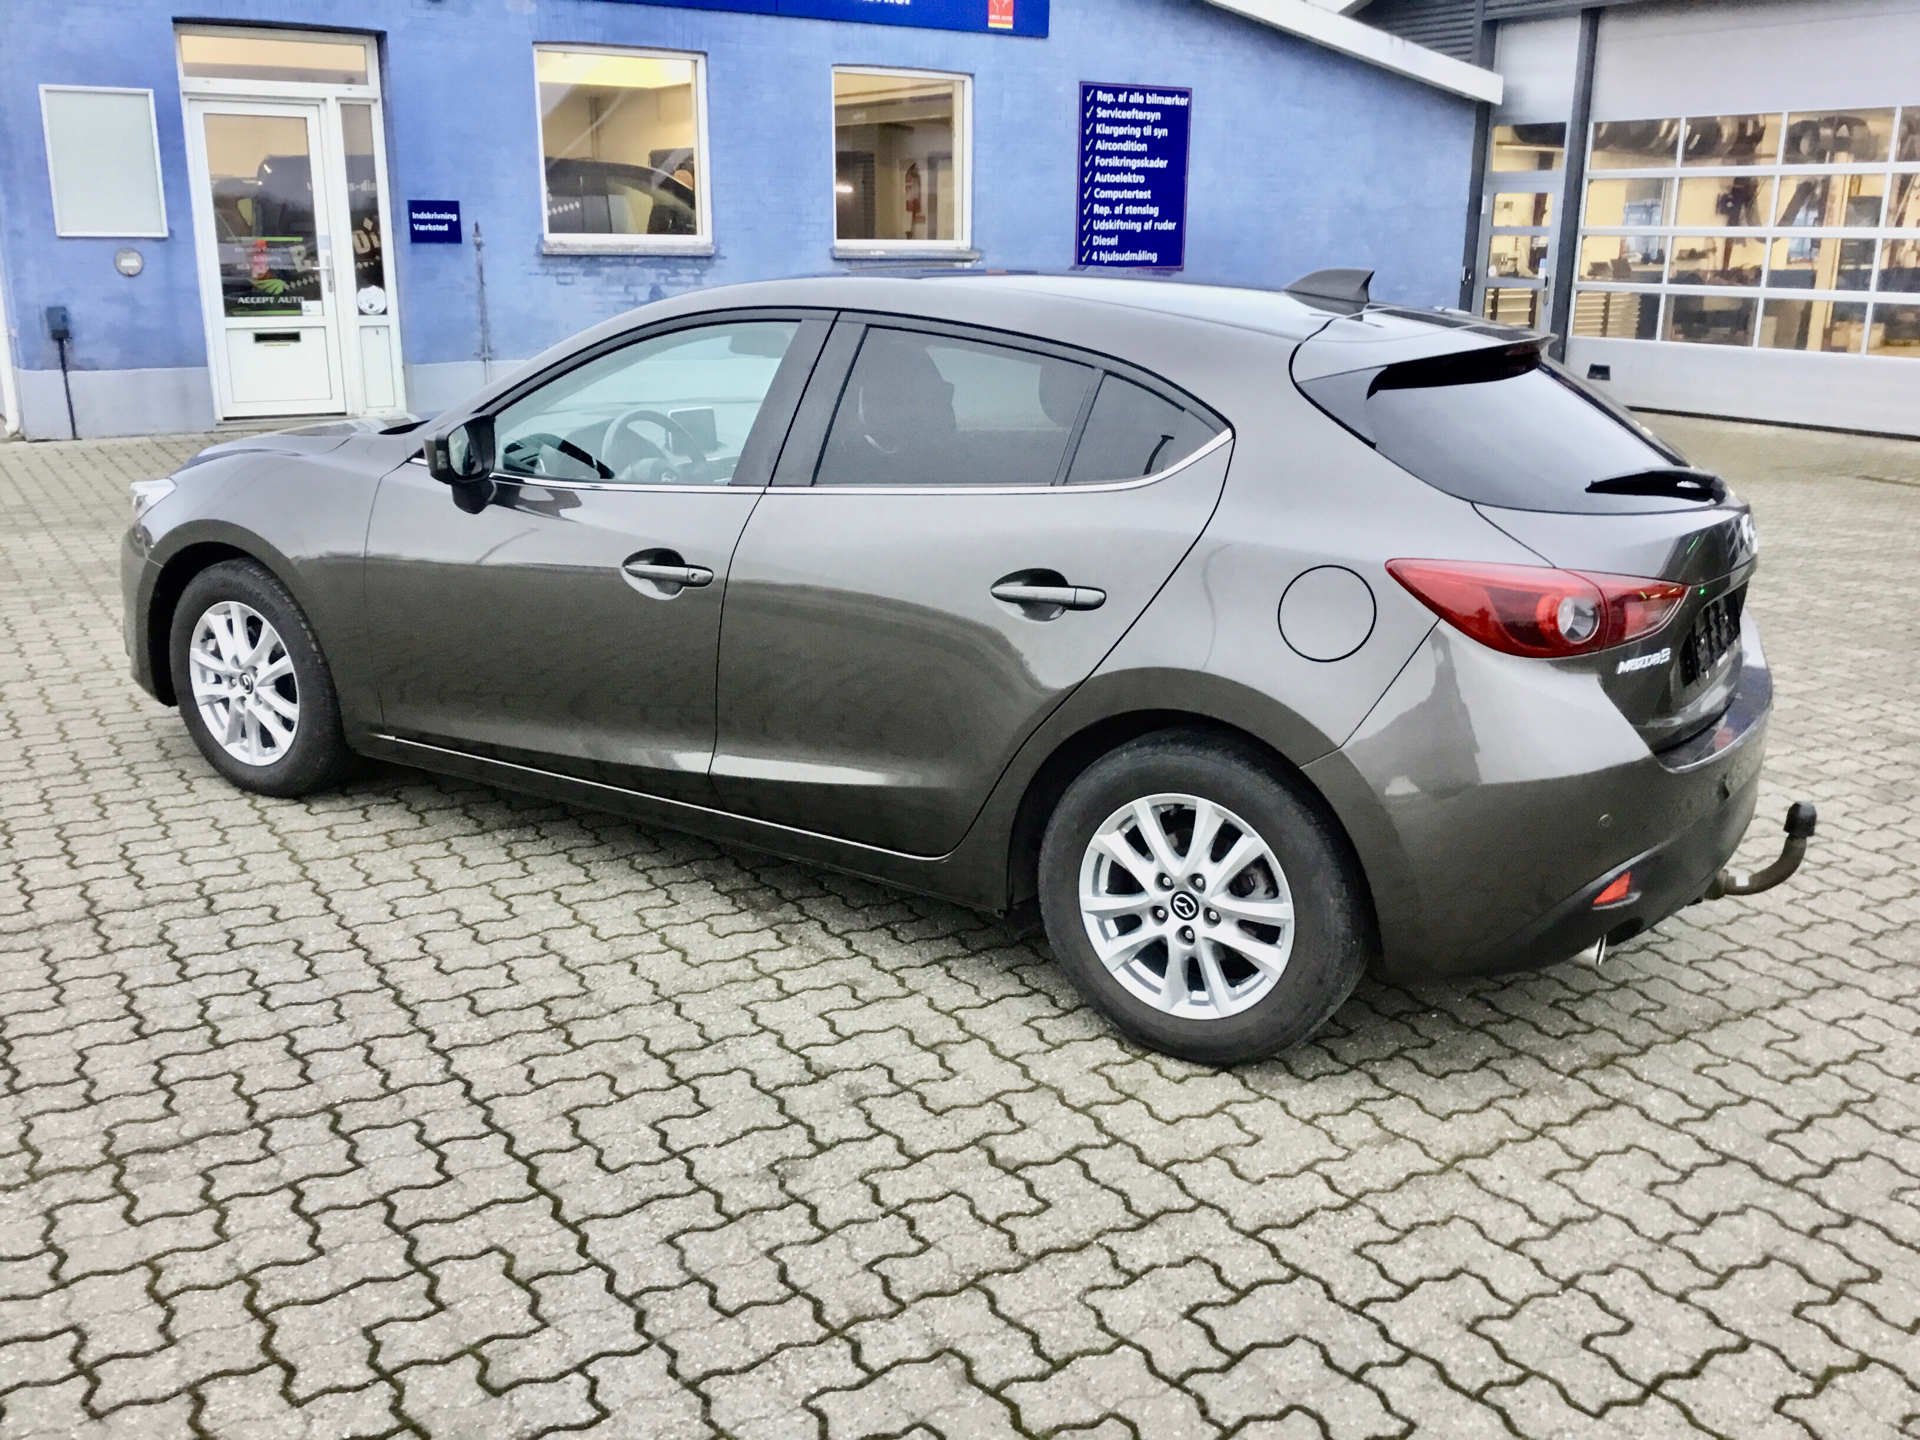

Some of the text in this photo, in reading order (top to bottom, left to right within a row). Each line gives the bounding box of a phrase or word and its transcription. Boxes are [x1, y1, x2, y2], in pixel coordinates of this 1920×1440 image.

[1096, 90, 1189, 106] Rep. af alle bilmærker
[1096, 107, 1161, 123] Serviceeftersyn
[1096, 123, 1168, 139] Klargøring til syn
[1095, 139, 1148, 152] Aircondition
[1094, 155, 1168, 170] Forsikringsskader
[1094, 172, 1145, 184] Autoelektro
[1093, 188, 1151, 201] Computertest
[412, 211, 457, 222] Indskrivning
[1093, 203, 1159, 217] Rep. af stenslag
[413, 223, 449, 231] Værksted
[1093, 219, 1177, 233] Udskiftning af ruder
[1092, 234, 1118, 246] Diesel
[1091, 250, 1158, 264] 4 hjulsudmåling
[237, 296, 305, 304] ACCEPT AUTO
